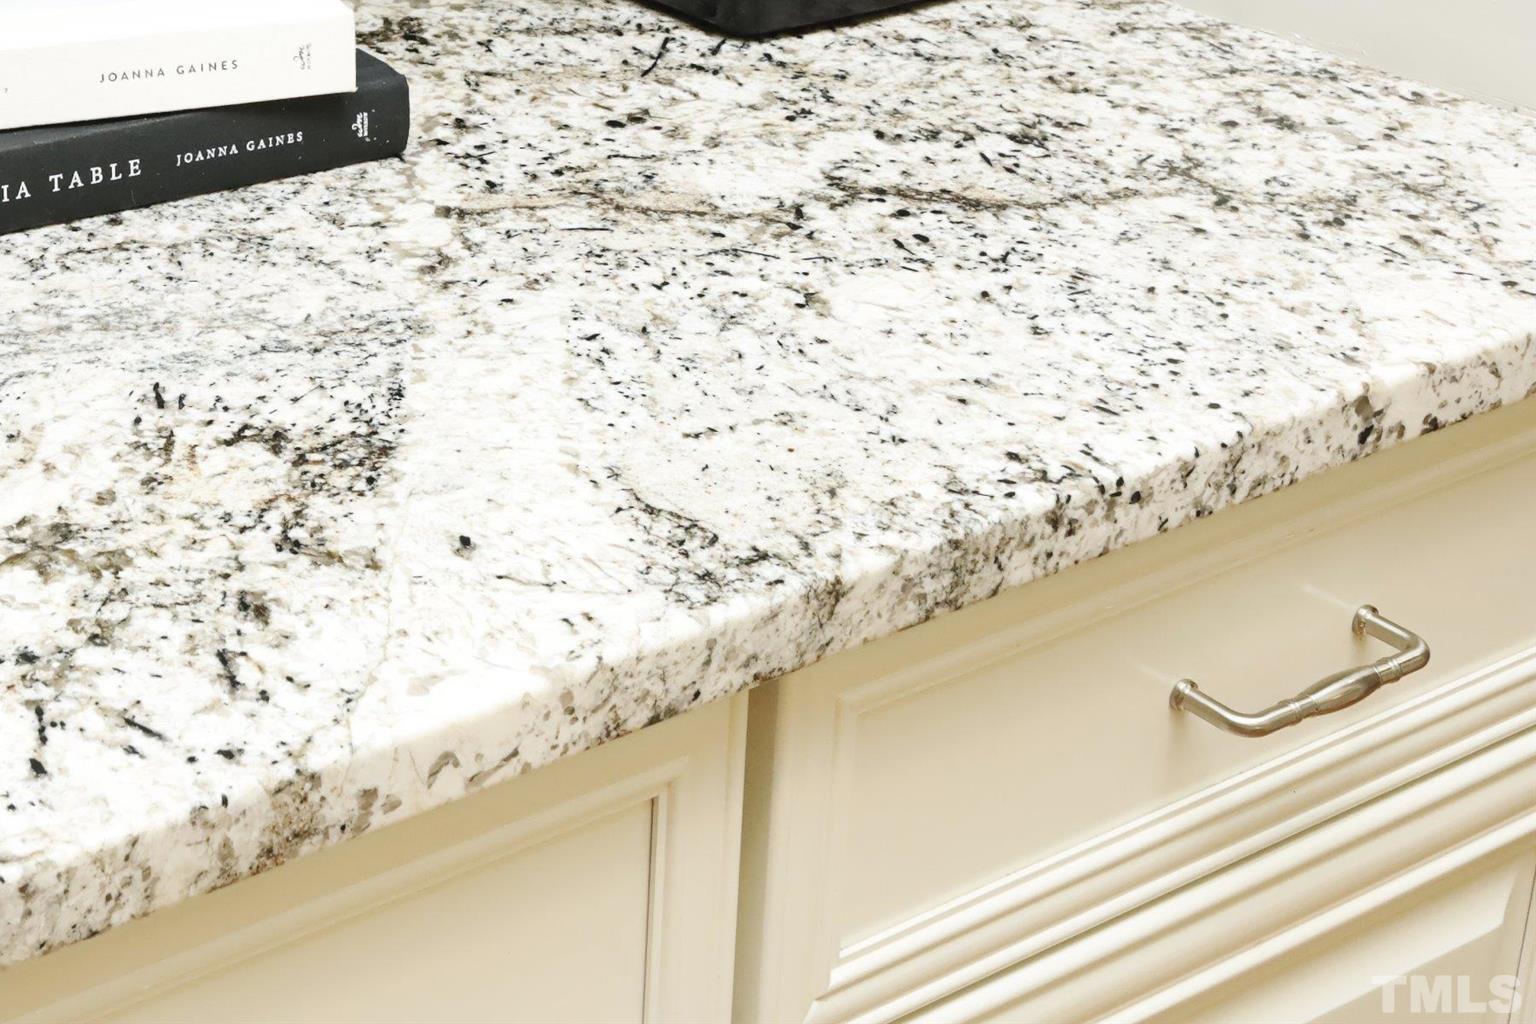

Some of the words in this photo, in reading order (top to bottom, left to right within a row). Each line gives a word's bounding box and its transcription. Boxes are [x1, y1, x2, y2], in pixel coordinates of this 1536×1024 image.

[99, 68, 165, 83] JOANNA
[176, 59, 240, 76] GAINES
[176, 144, 239, 167] JOANNA
[246, 131, 304, 152] GAINES
[48, 158, 142, 192] TABLE
